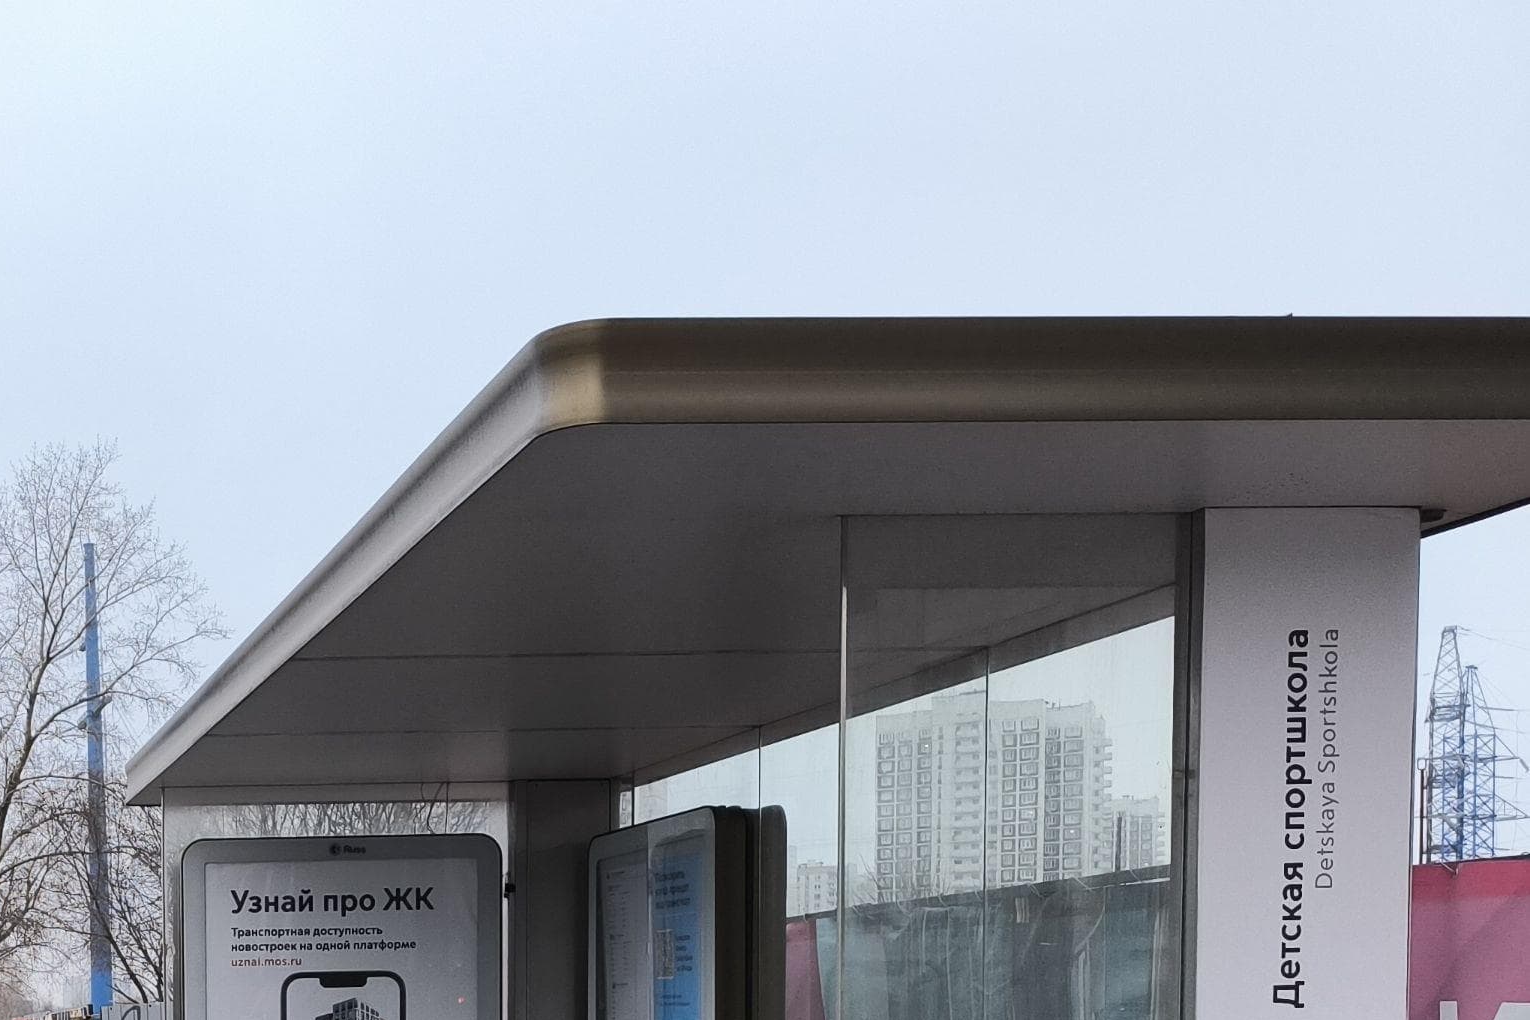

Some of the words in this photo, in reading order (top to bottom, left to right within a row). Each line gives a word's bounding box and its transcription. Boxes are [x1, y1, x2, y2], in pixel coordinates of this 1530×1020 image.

[1317, 629, 1341, 773] Sportshkola
[1283, 629, 1313, 850] спортшкола
[1315, 783, 1341, 890] Detskaya
[230, 888, 314, 914] Узнай
[323, 894, 376, 917] про
[383, 887, 435, 911] ЖК
[231, 926, 310, 939] Транспортная
[313, 925, 382, 938] доступность
[1272, 861, 1305, 1008] Детская
[231, 943, 297, 954] новостроек
[299, 943, 313, 951] на
[315, 940, 351, 952] одной
[353, 939, 416, 953] платформе
[231, 957, 302, 967] uznai.mos.ru
